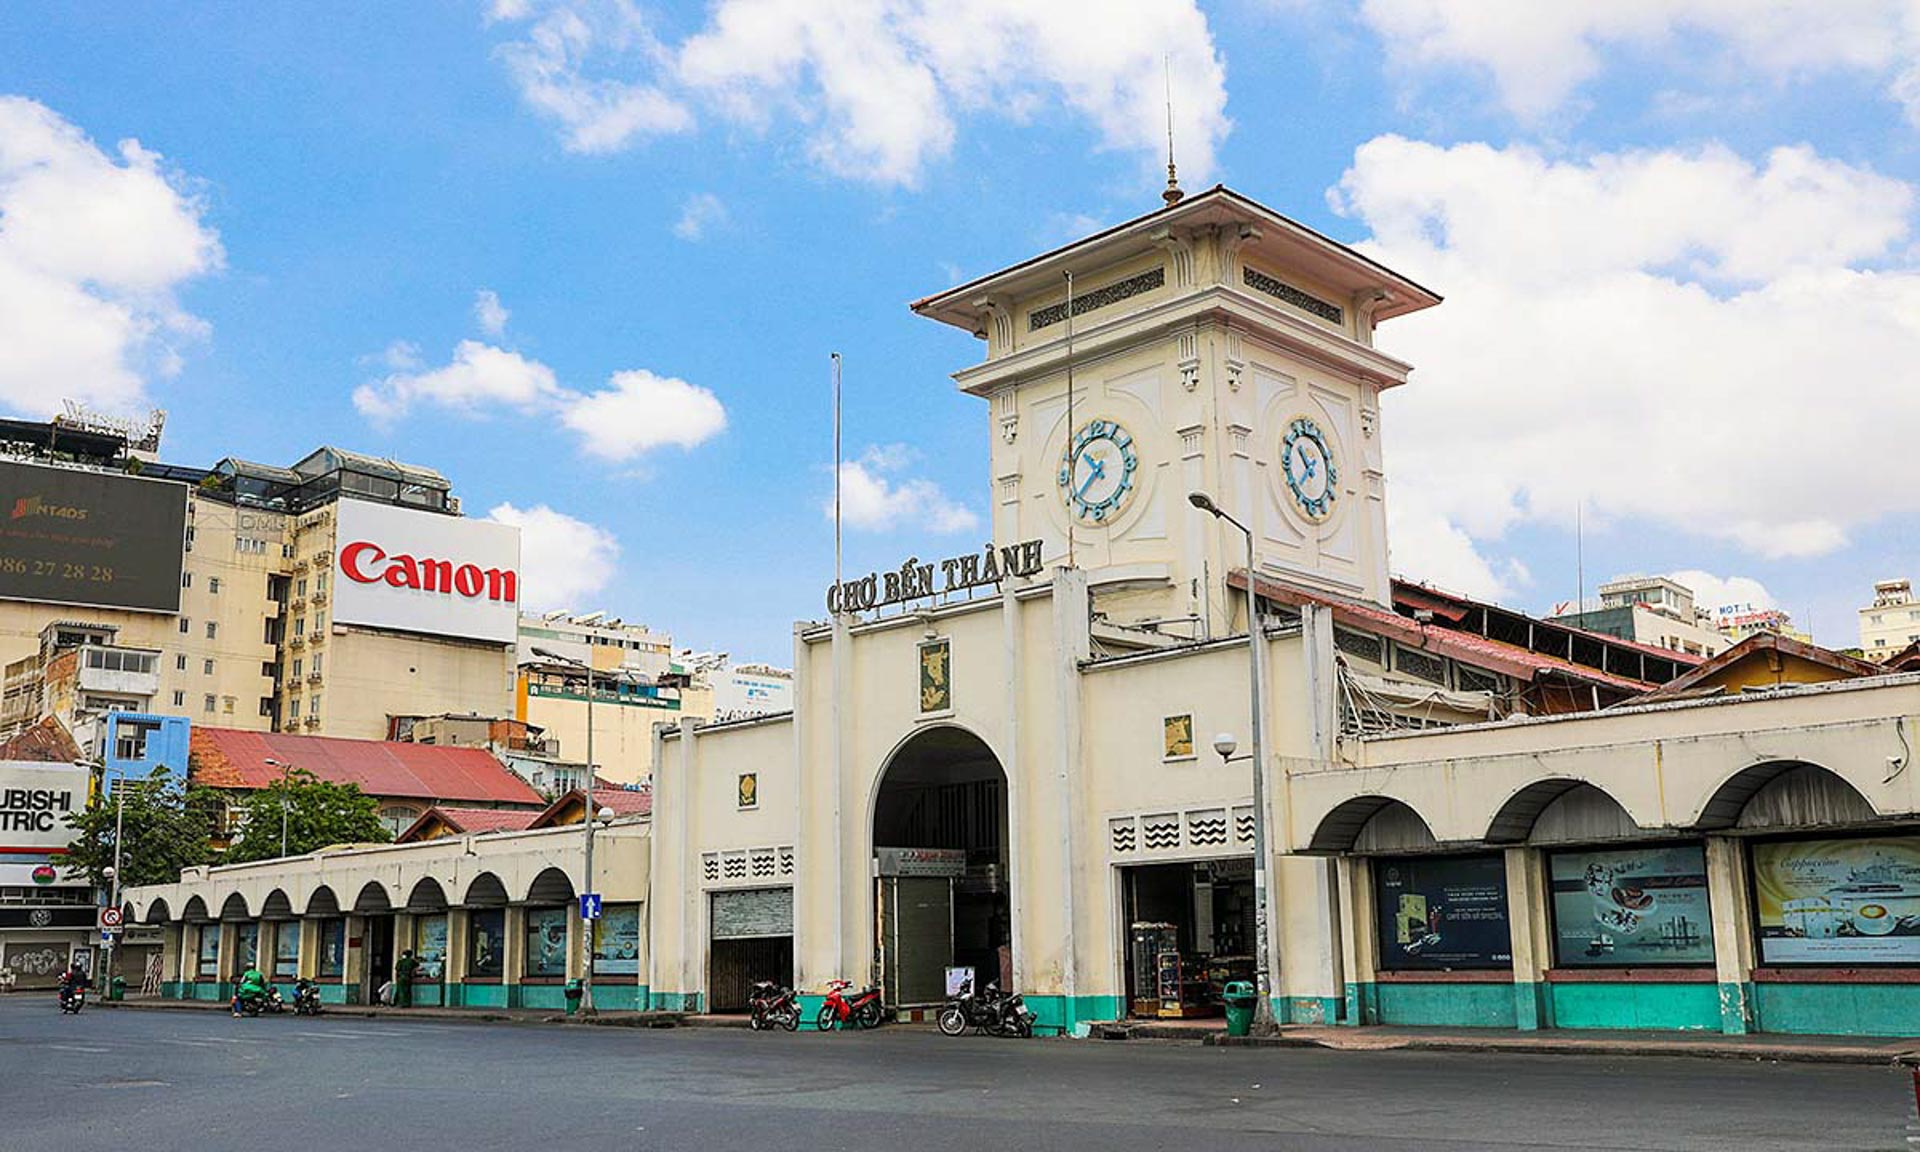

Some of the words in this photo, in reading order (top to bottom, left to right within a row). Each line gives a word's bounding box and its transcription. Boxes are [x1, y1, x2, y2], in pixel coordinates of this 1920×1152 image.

[0, 557, 26, 576] 86
[33, 561, 57, 577] 27
[63, 562, 85, 579] 28
[91, 565, 113, 583] 28
[339, 541, 516, 603] Canon
[827, 573, 878, 615] CHỢ
[883, 557, 935, 601] BẾN
[942, 539, 1044, 591] THÀNH
[0, 811, 55, 832] TRIC
